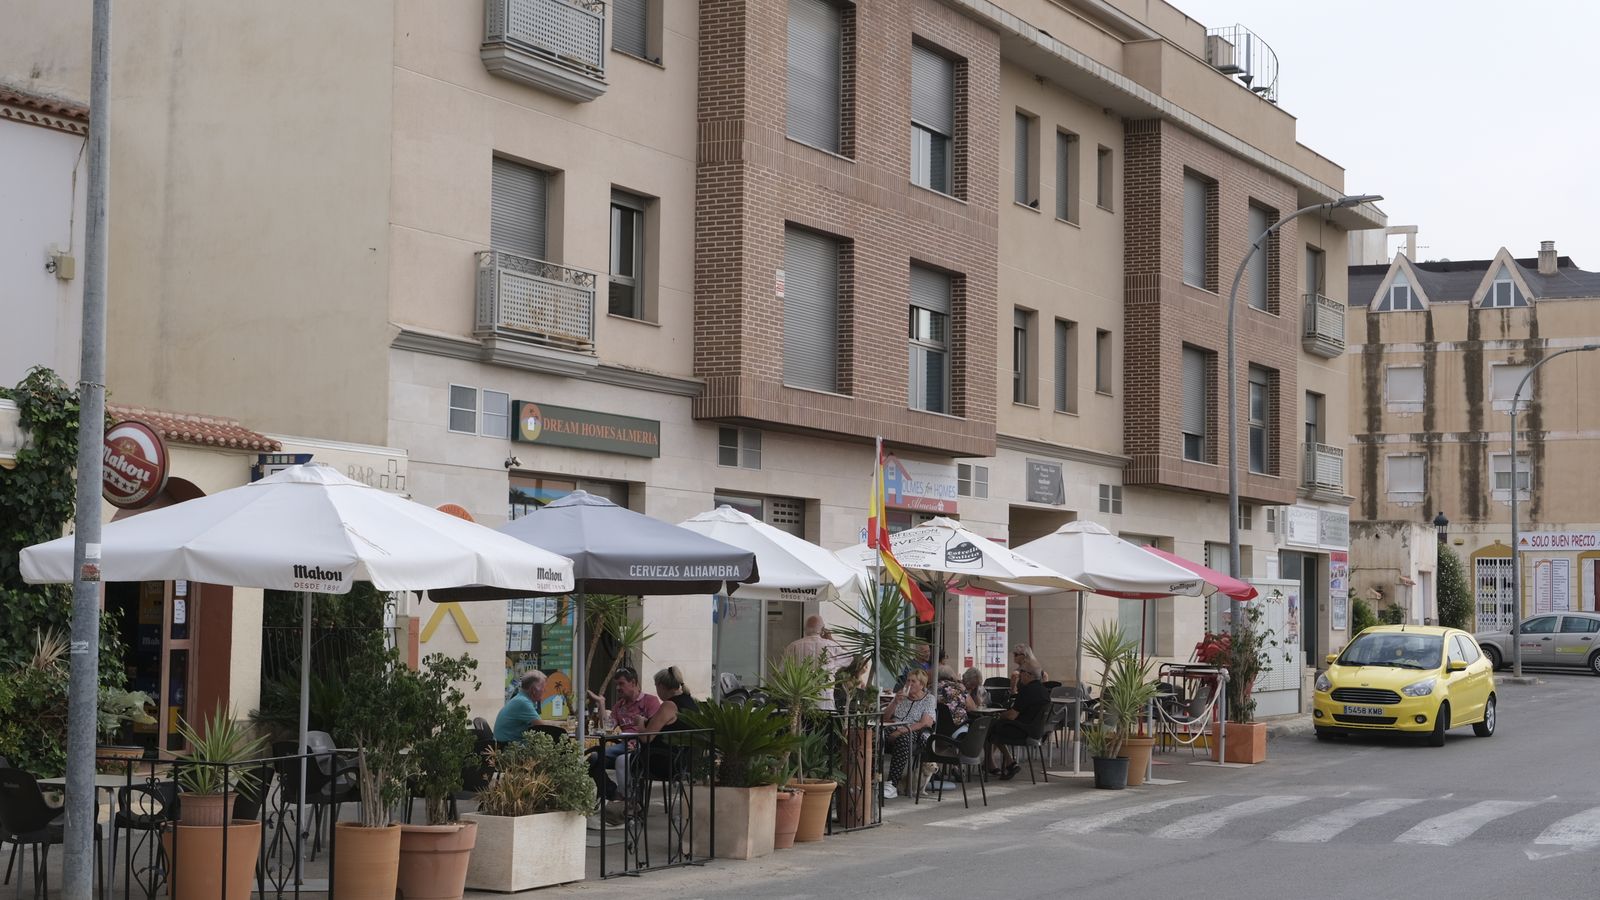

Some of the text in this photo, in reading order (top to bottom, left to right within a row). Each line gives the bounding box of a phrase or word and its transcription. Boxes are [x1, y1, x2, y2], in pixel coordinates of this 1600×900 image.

[543, 417, 658, 446] DREAM HOMES ALMERIA
[933, 483, 956, 498] HOMES
[1531, 534, 1596, 547] SOLO BUEN PRECIO
[293, 564, 342, 581] Mahou
[536, 566, 563, 581] Mahou
[629, 564, 740, 577] CERVEZAS ALHAMBRA
[294, 582, 320, 590] DESDE
[1348, 706, 1367, 714] 5458
